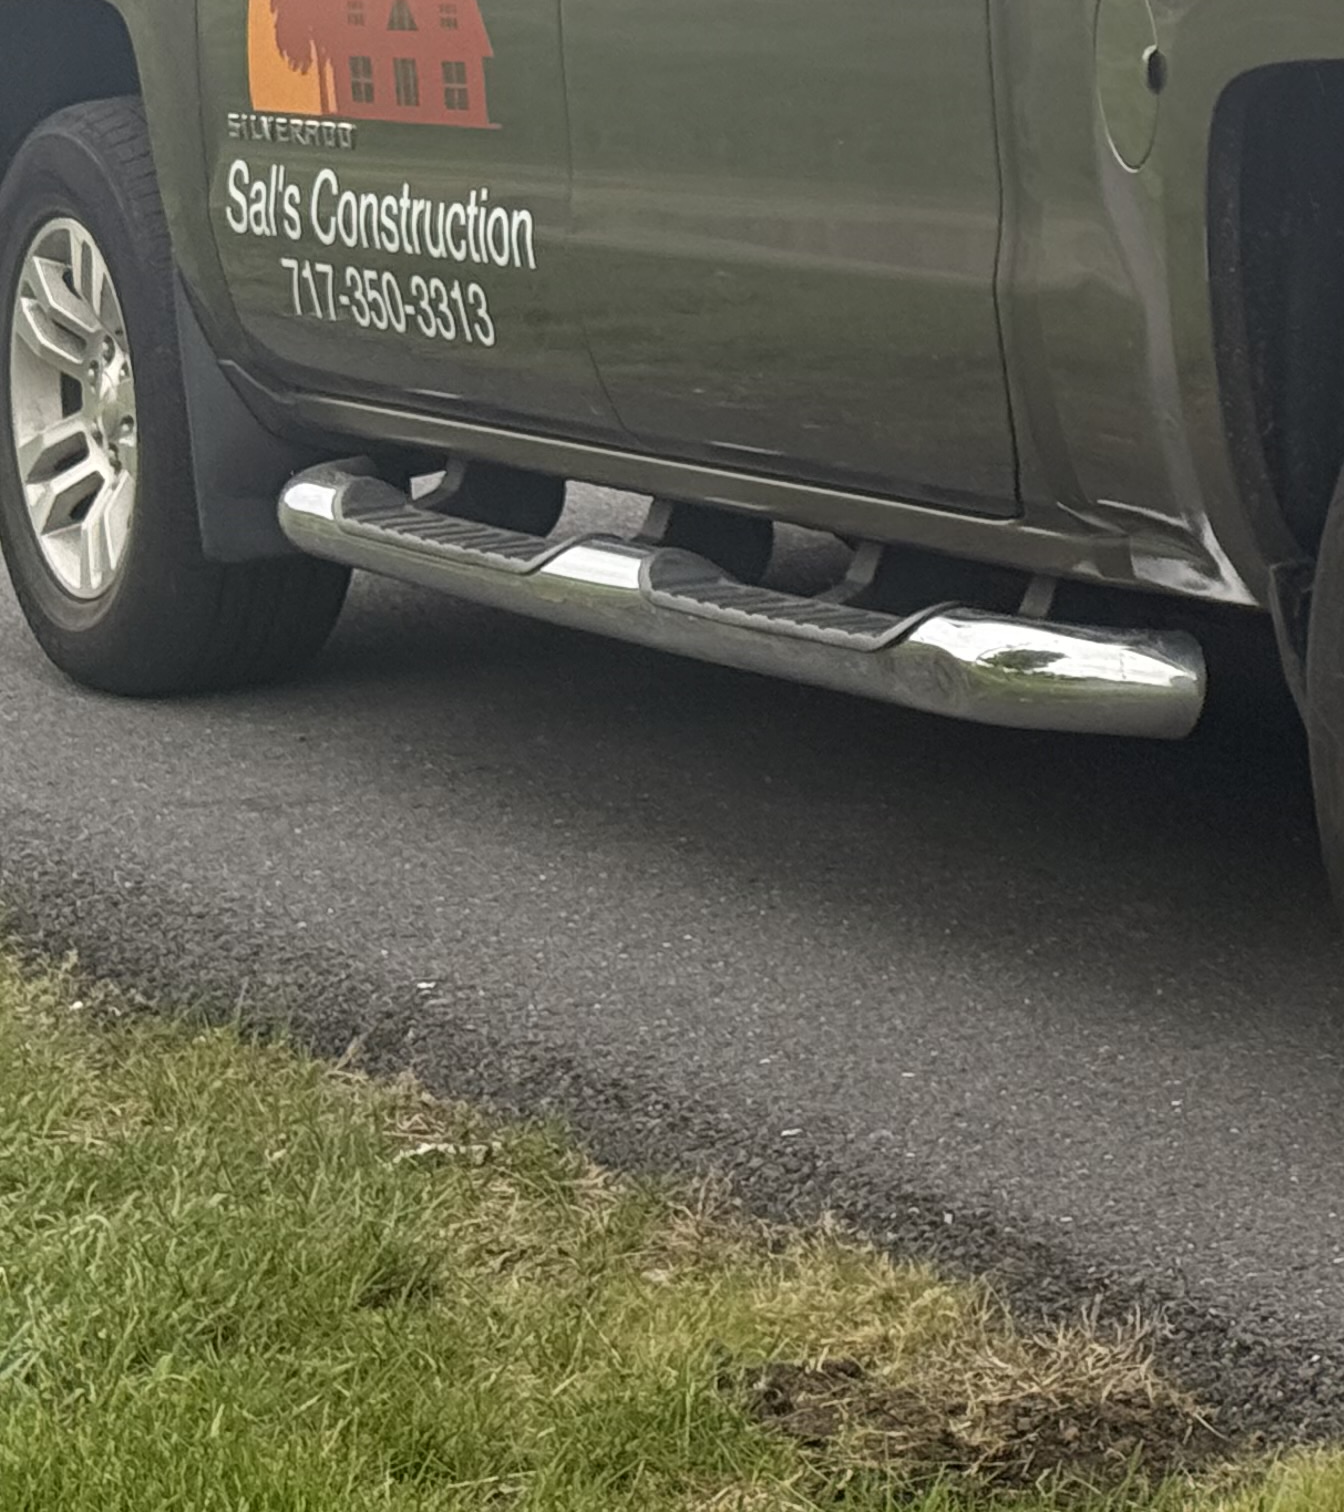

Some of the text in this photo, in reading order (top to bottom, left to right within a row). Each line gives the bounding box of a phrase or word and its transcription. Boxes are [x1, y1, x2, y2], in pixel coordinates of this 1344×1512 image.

[226, 112, 357, 151] SILVERADO
[225, 158, 537, 269] Sal's Construction
[279, 256, 496, 347] 717-350-3313
